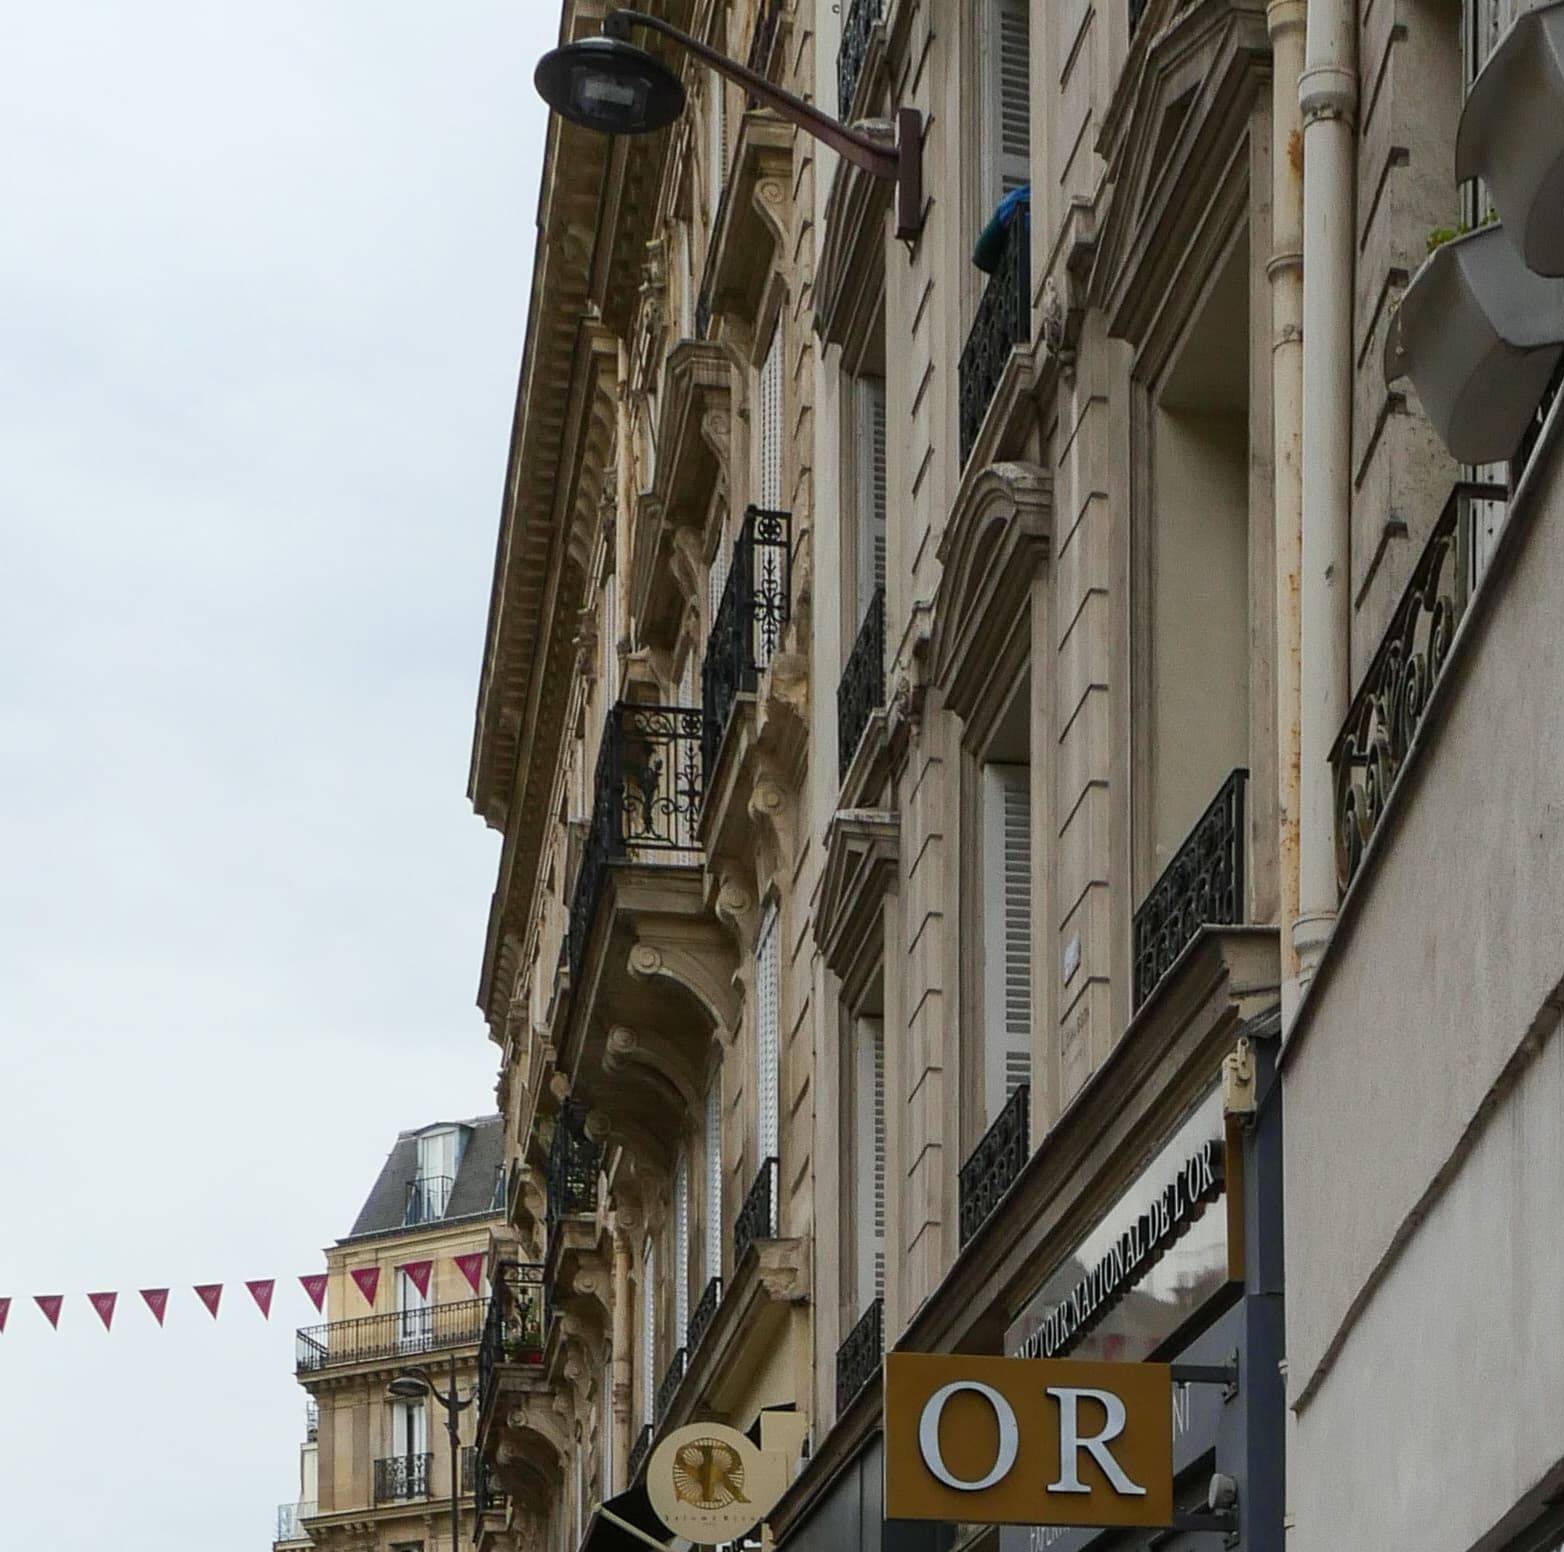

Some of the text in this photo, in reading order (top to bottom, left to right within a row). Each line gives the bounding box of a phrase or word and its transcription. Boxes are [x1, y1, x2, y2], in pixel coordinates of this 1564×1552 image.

[1071, 1226, 1144, 1331] NATIONAL
[1149, 1189, 1170, 1249] DE
[1174, 1141, 1214, 1222] L'OR
[919, 1380, 1147, 1496] OR
